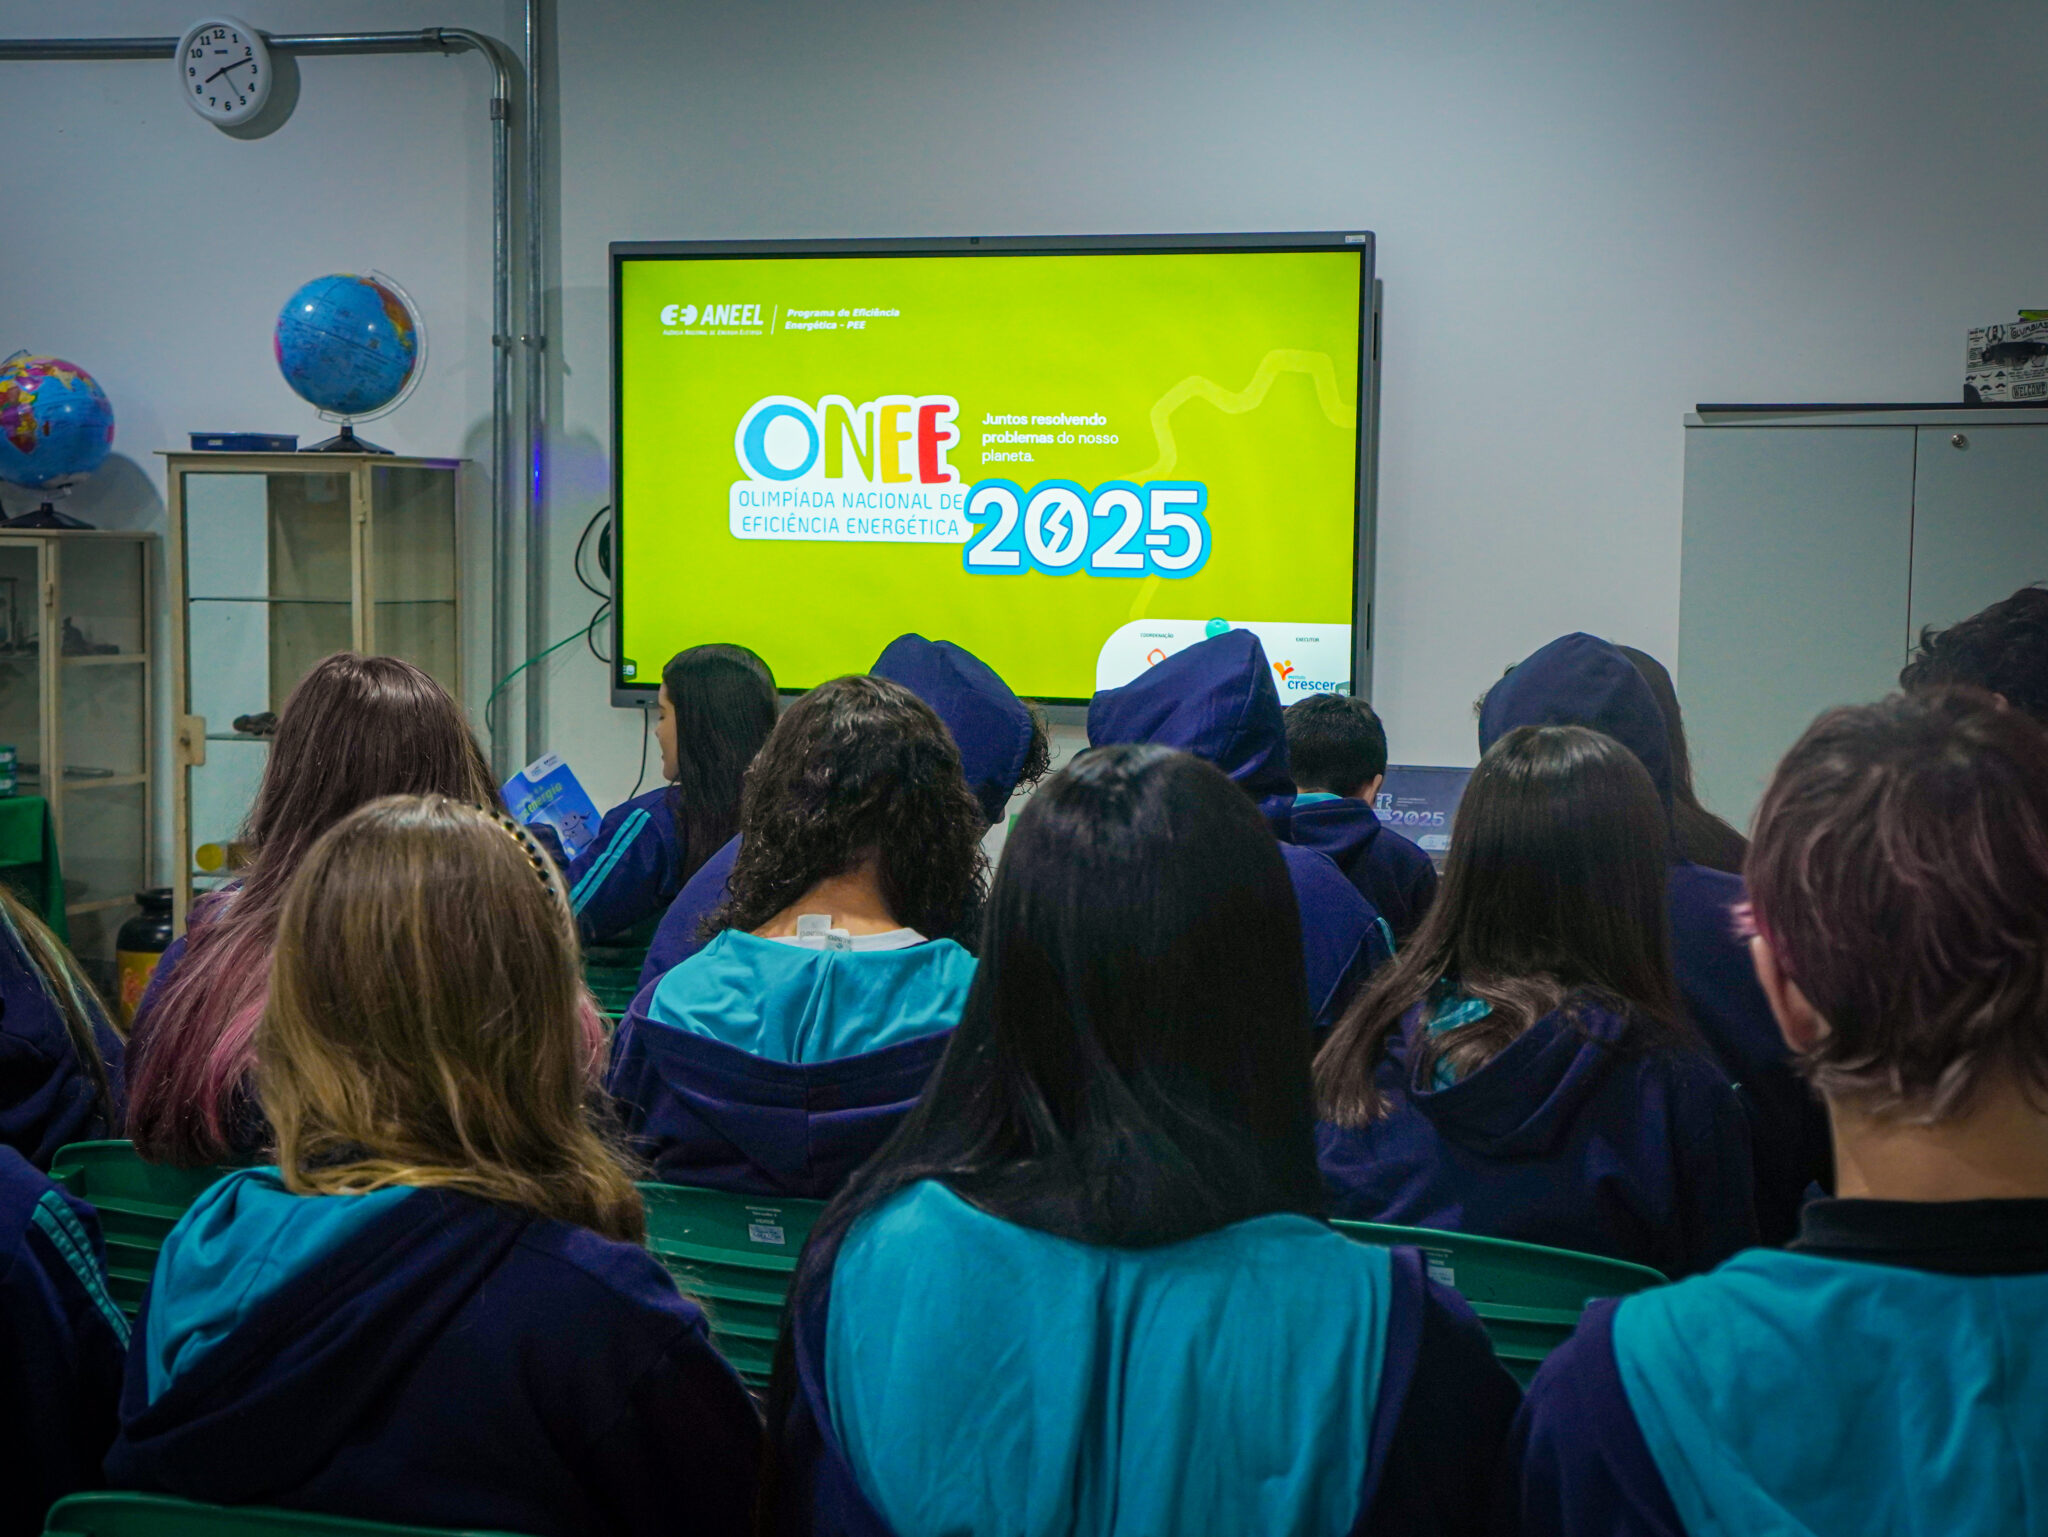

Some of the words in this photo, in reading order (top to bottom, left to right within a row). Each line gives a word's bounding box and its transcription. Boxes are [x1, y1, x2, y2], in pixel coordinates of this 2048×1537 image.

[213, 29, 225, 39] 12
[232, 34, 238, 43] 1
[200, 36, 211, 45] 11
[191, 48, 202, 58] 10
[245, 46, 252, 56] 2
[189, 67, 196, 77] 9
[251, 64, 257, 74] 3
[195, 84, 202, 94] 8
[248, 82, 255, 92] 4
[209, 97, 216, 107] 7
[240, 96, 246, 105] 5
[224, 101, 231, 111] 6
[700, 304, 764, 326] ANEEL
[787, 308, 835, 319] Programa
[837, 308, 850, 317] de
[852, 307, 900, 317] Eficiência
[785, 320, 837, 331] Energética
[846, 320, 867, 329] PEE
[982, 412, 1028, 425] Juntos
[1031, 412, 1107, 426] resolvendo
[982, 430, 1054, 446] problemas
[1056, 431, 1075, 444] do
[1078, 434, 1119, 444] nosso
[743, 403, 952, 485] ONEE
[982, 448, 1035, 465] planeta.
[738, 487, 835, 508] OLIMPÍADA
[842, 491, 932, 510] NACIONAL
[940, 493, 963, 510] DE
[742, 512, 839, 533] EFICIÊNCIA
[846, 514, 959, 535] ENERGÉTICA
[967, 485, 1204, 571] 2025
[1288, 680, 1336, 690] crescer
[1390, 810, 1446, 827] 2025
